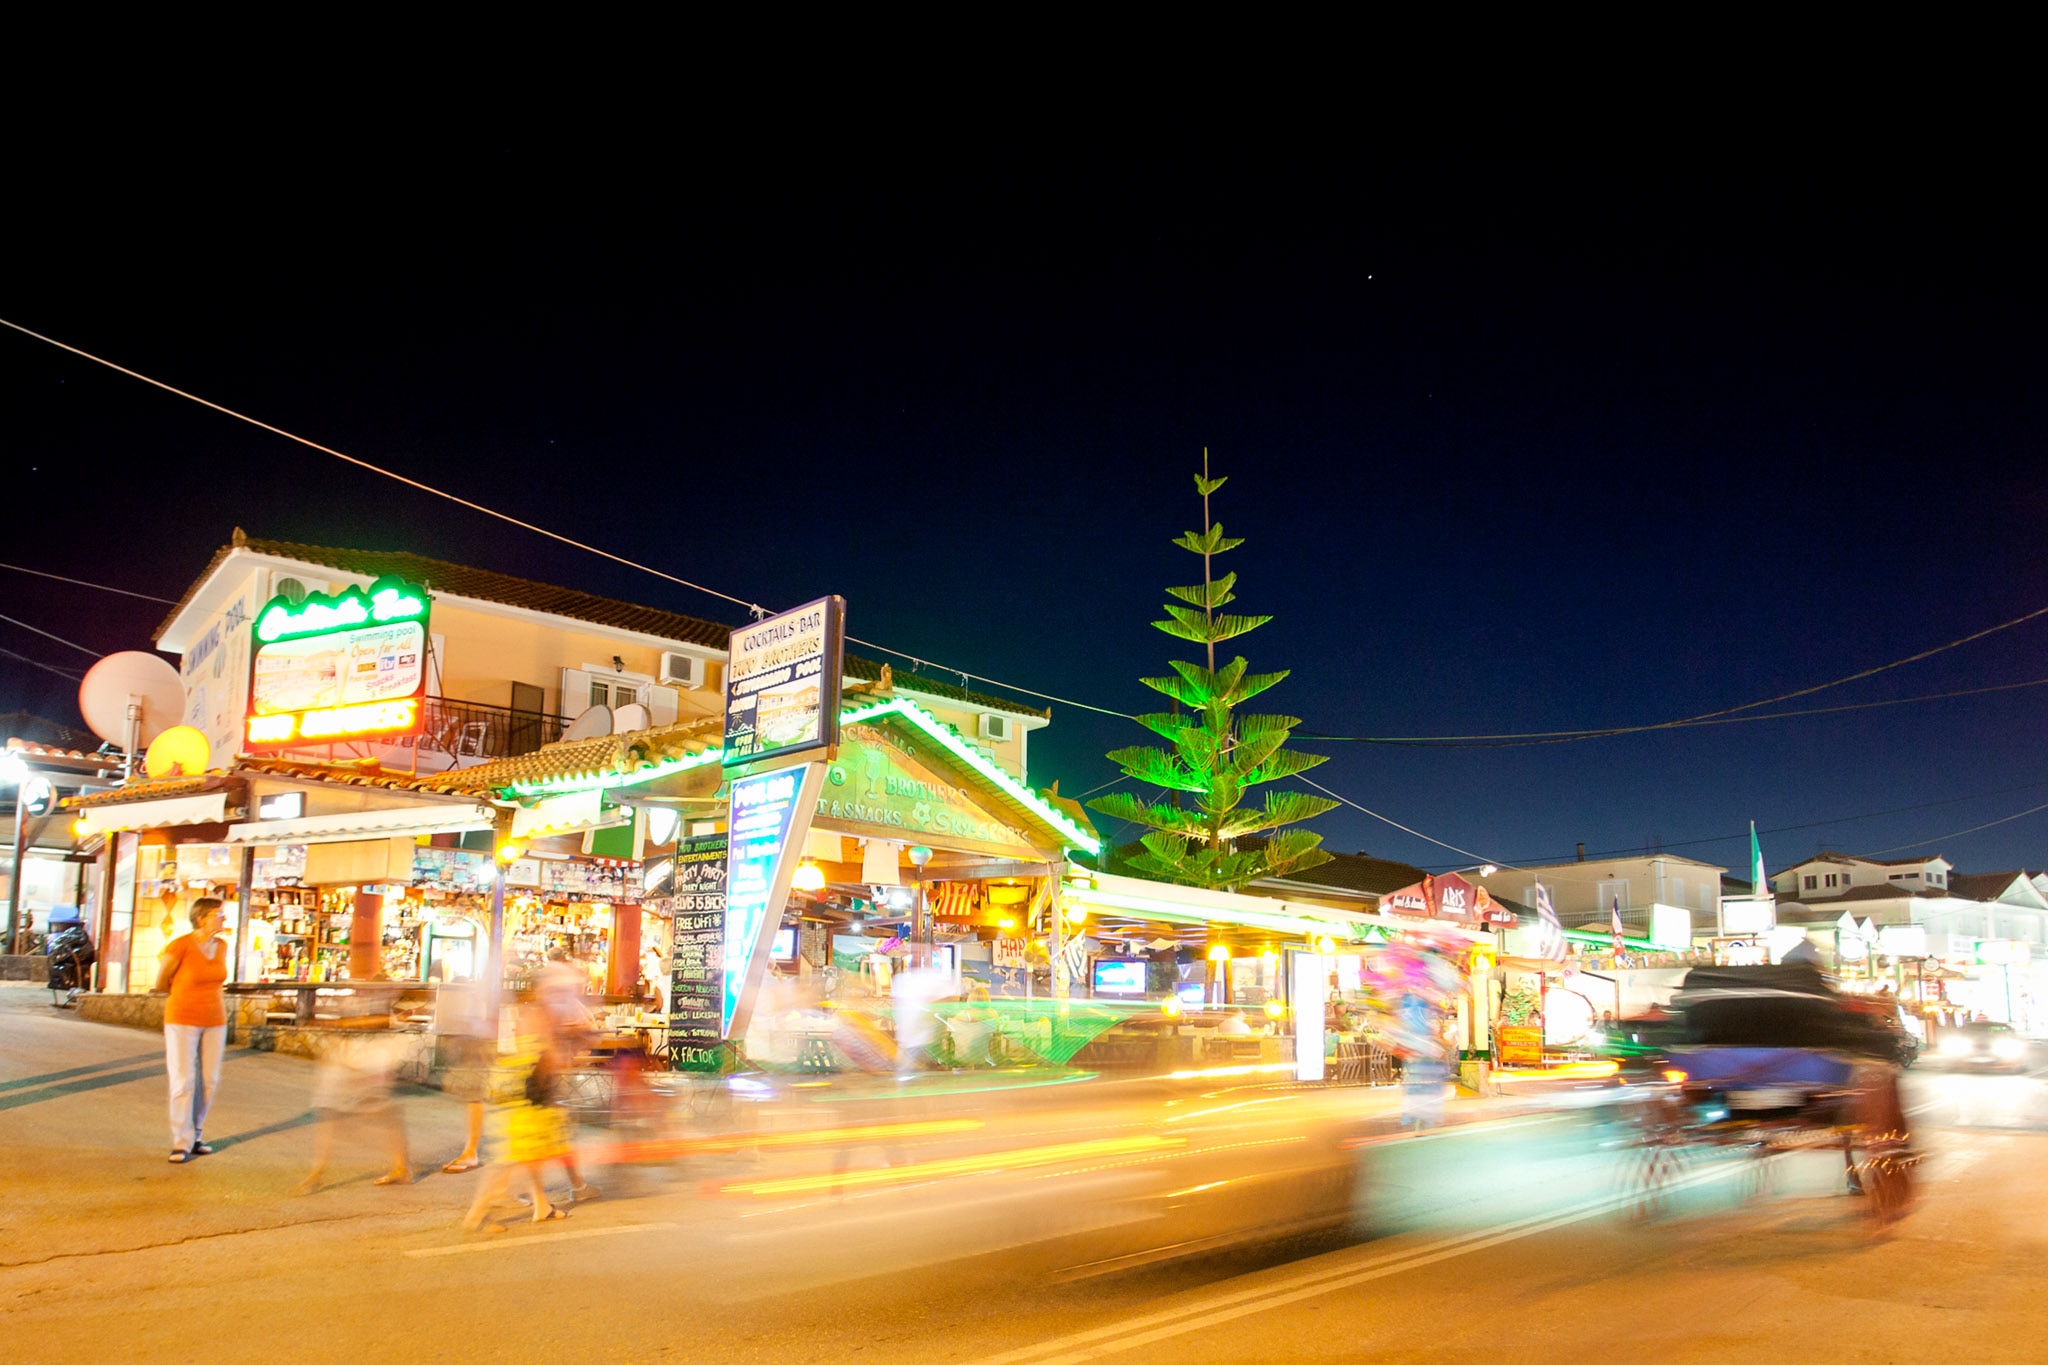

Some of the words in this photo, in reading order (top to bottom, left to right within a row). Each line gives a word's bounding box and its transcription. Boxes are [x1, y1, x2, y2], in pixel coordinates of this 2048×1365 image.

[349, 629, 394, 644] Swimming
[396, 624, 416, 638] pool
[744, 621, 794, 652] COCKTAILS
[800, 611, 821, 633] BAR
[352, 642, 376, 663] Open
[377, 638, 395, 658] for
[397, 636, 414, 651] all
[732, 657, 758, 678] TWO
[761, 636, 820, 670] BROTHERS
[366, 674, 394, 690] Snacks
[379, 673, 417, 694] Breakfast
[737, 667, 791, 696] SWIMMING
[795, 656, 822, 678] POOL
[840, 726, 915, 758] OCKTAILS
[885, 775, 968, 806] BROTHERS
[694, 840, 728, 852] BROTHERS
[678, 850, 727, 864] ENTERTAINMENTS
[675, 863, 698, 888] PARTY
[700, 863, 728, 884] PARTY
[682, 881, 699, 892] EVERY
[699, 880, 718, 891] NIGHT
[675, 894, 695, 911] ELVIS
[696, 895, 704, 910] IS
[704, 894, 727, 910] BACK
[1442, 886, 1465, 909] ARIS
[676, 916, 694, 931] FREE
[670, 1046, 679, 1061] X
[681, 1046, 715, 1065] FACTOR
